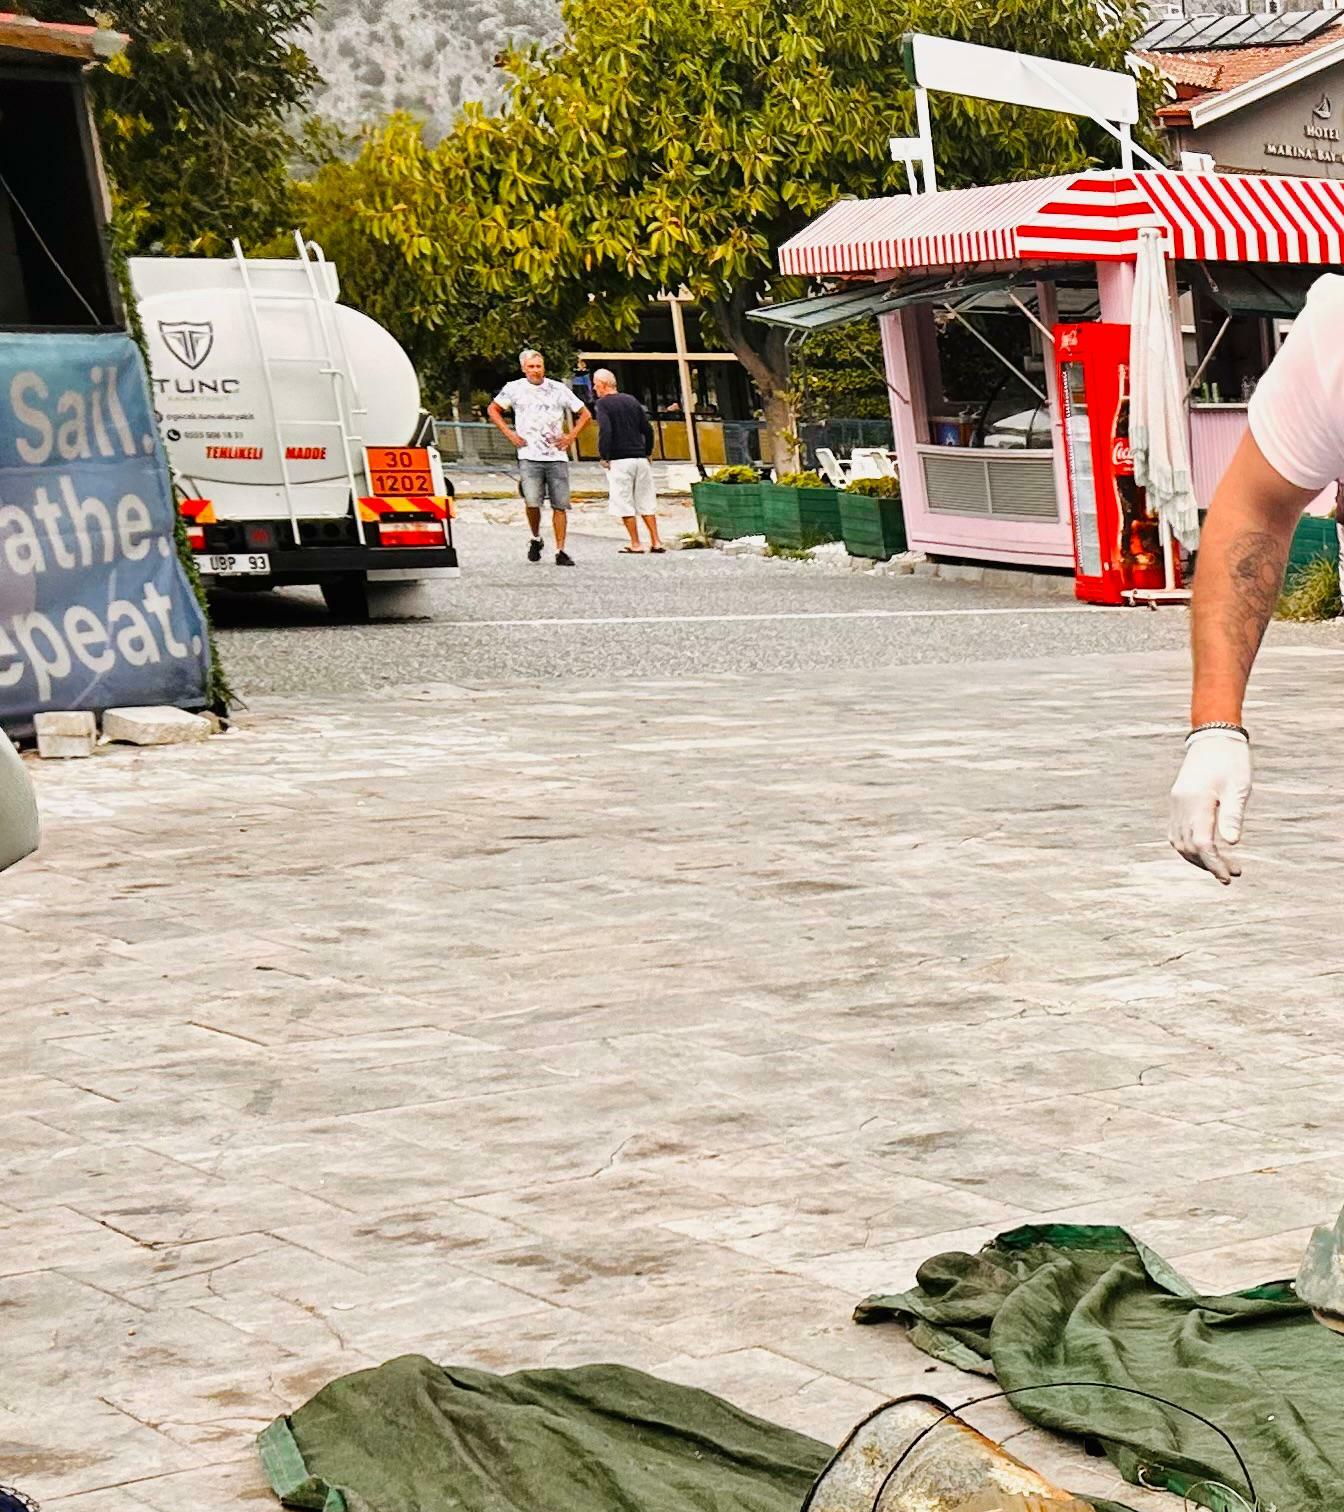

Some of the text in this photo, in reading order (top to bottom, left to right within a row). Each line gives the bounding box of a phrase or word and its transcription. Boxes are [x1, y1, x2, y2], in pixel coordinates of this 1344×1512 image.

[1305, 125, 1340, 140] HOTEL
[1265, 143, 1312, 160] MARINA
[1316, 149, 1336, 162] BAY
[10, 366, 155, 464] Sail.
[285, 447, 328, 460] MADDE
[384, 451, 413, 468] 30
[376, 475, 429, 491] 1202
[248, 556, 266, 570] 93
